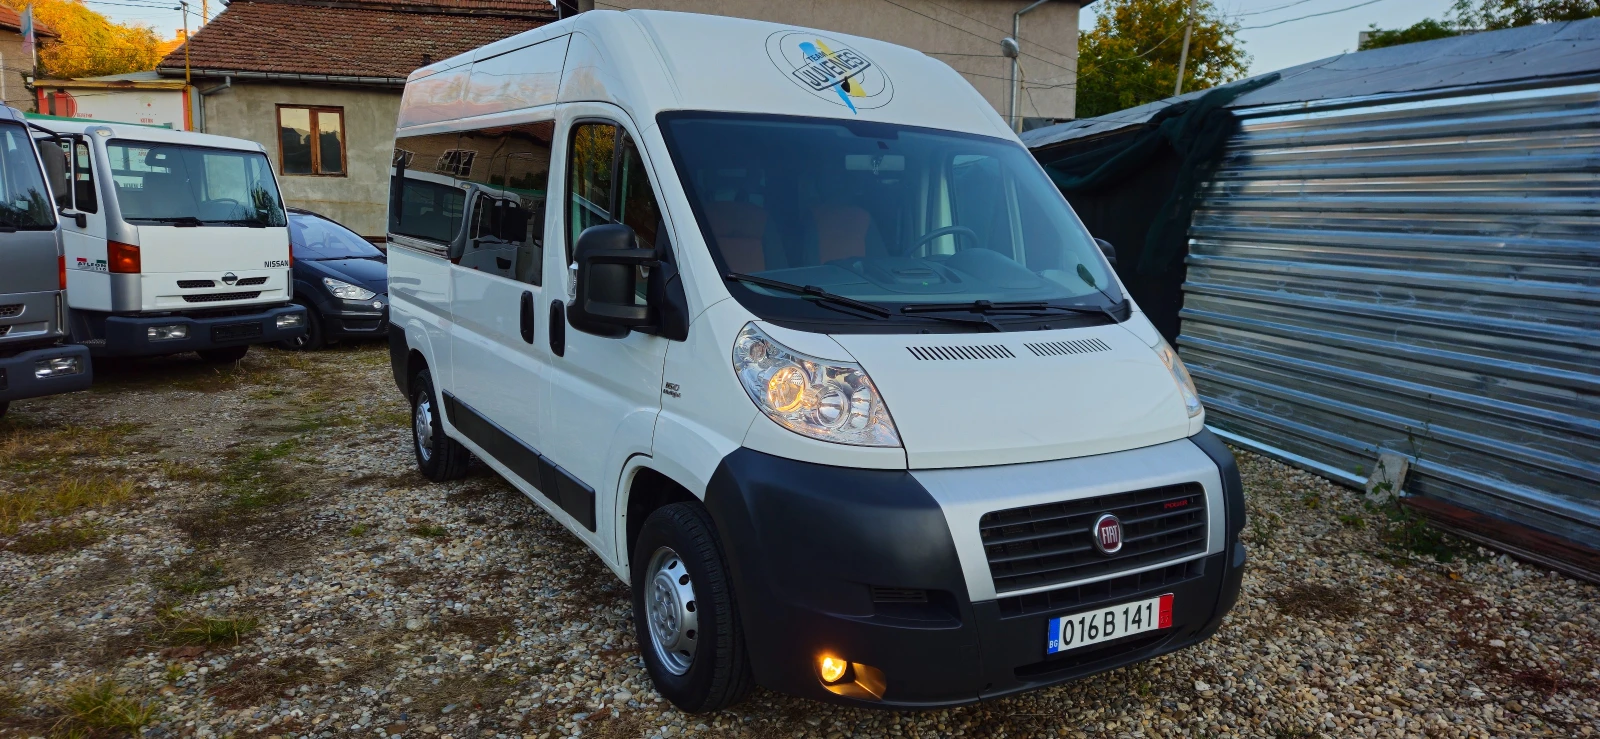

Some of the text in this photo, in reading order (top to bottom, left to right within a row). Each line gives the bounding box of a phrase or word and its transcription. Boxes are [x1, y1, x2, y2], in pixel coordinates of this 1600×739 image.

[806, 51, 829, 63] TEAM
[802, 52, 865, 87] JUVENES
[264, 260, 289, 268] NISSAN
[1101, 524, 1118, 545] FIAT
[1049, 639, 1059, 649] BG
